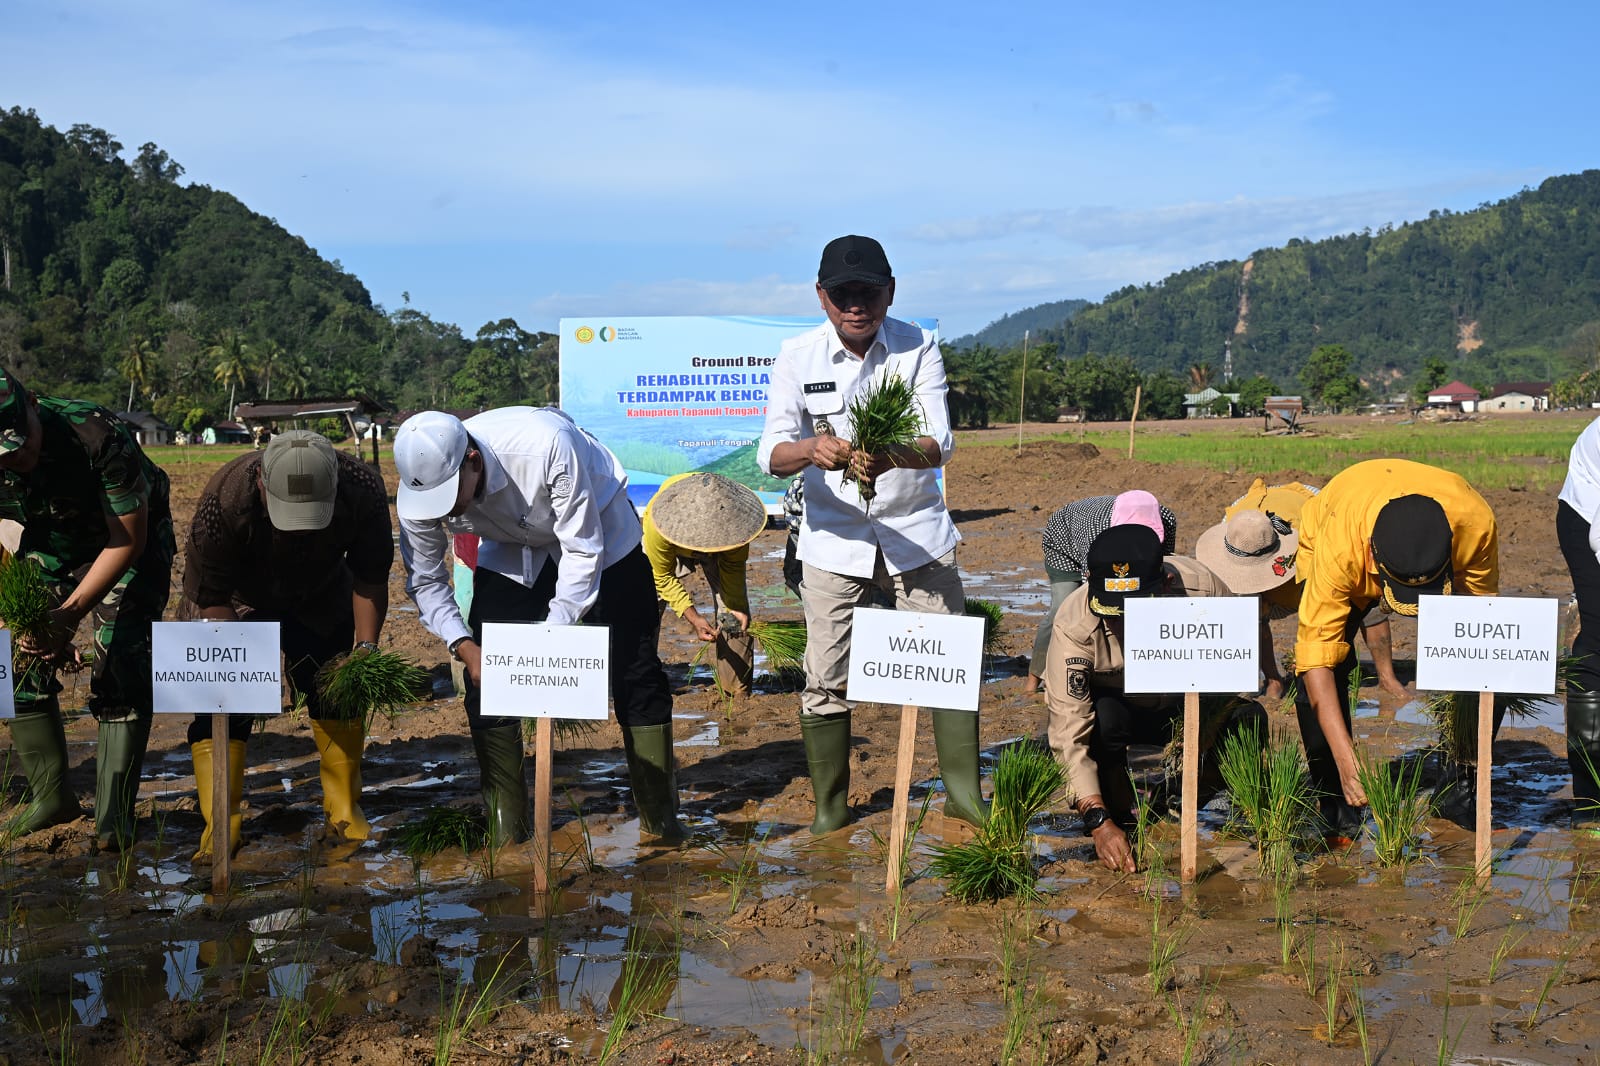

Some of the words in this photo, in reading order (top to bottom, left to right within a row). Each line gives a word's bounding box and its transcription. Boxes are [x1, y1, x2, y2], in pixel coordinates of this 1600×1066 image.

[692, 356, 744, 368] Ground
[636, 373, 747, 387] REHABILITASI
[751, 373, 771, 385] LA
[617, 390, 717, 403] TERDAMPAK
[627, 408, 679, 418] Kabupaten
[681, 407, 723, 418] Tapanuli
[678, 440, 717, 448] Tapanuli
[719, 439, 756, 447] Tengah,
[1159, 623, 1223, 640] BUPATI
[1454, 623, 1520, 640] BUPATI
[888, 635, 946, 656] WAKIL
[186, 647, 247, 663] BUPATI
[1131, 648, 1193, 661] TAPANULI
[1197, 648, 1252, 660] TENGAH
[1424, 647, 1488, 660] TAPANULI
[1492, 649, 1550, 662] SELATAN
[485, 654, 514, 667] STAF
[517, 655, 544, 668] AHLI
[548, 657, 604, 670] MENTERI
[154, 671, 237, 684] MANDAILING
[240, 671, 279, 683] NATAL
[862, 661, 966, 685] GUBERNUR
[510, 674, 579, 688] PERTANIAN
